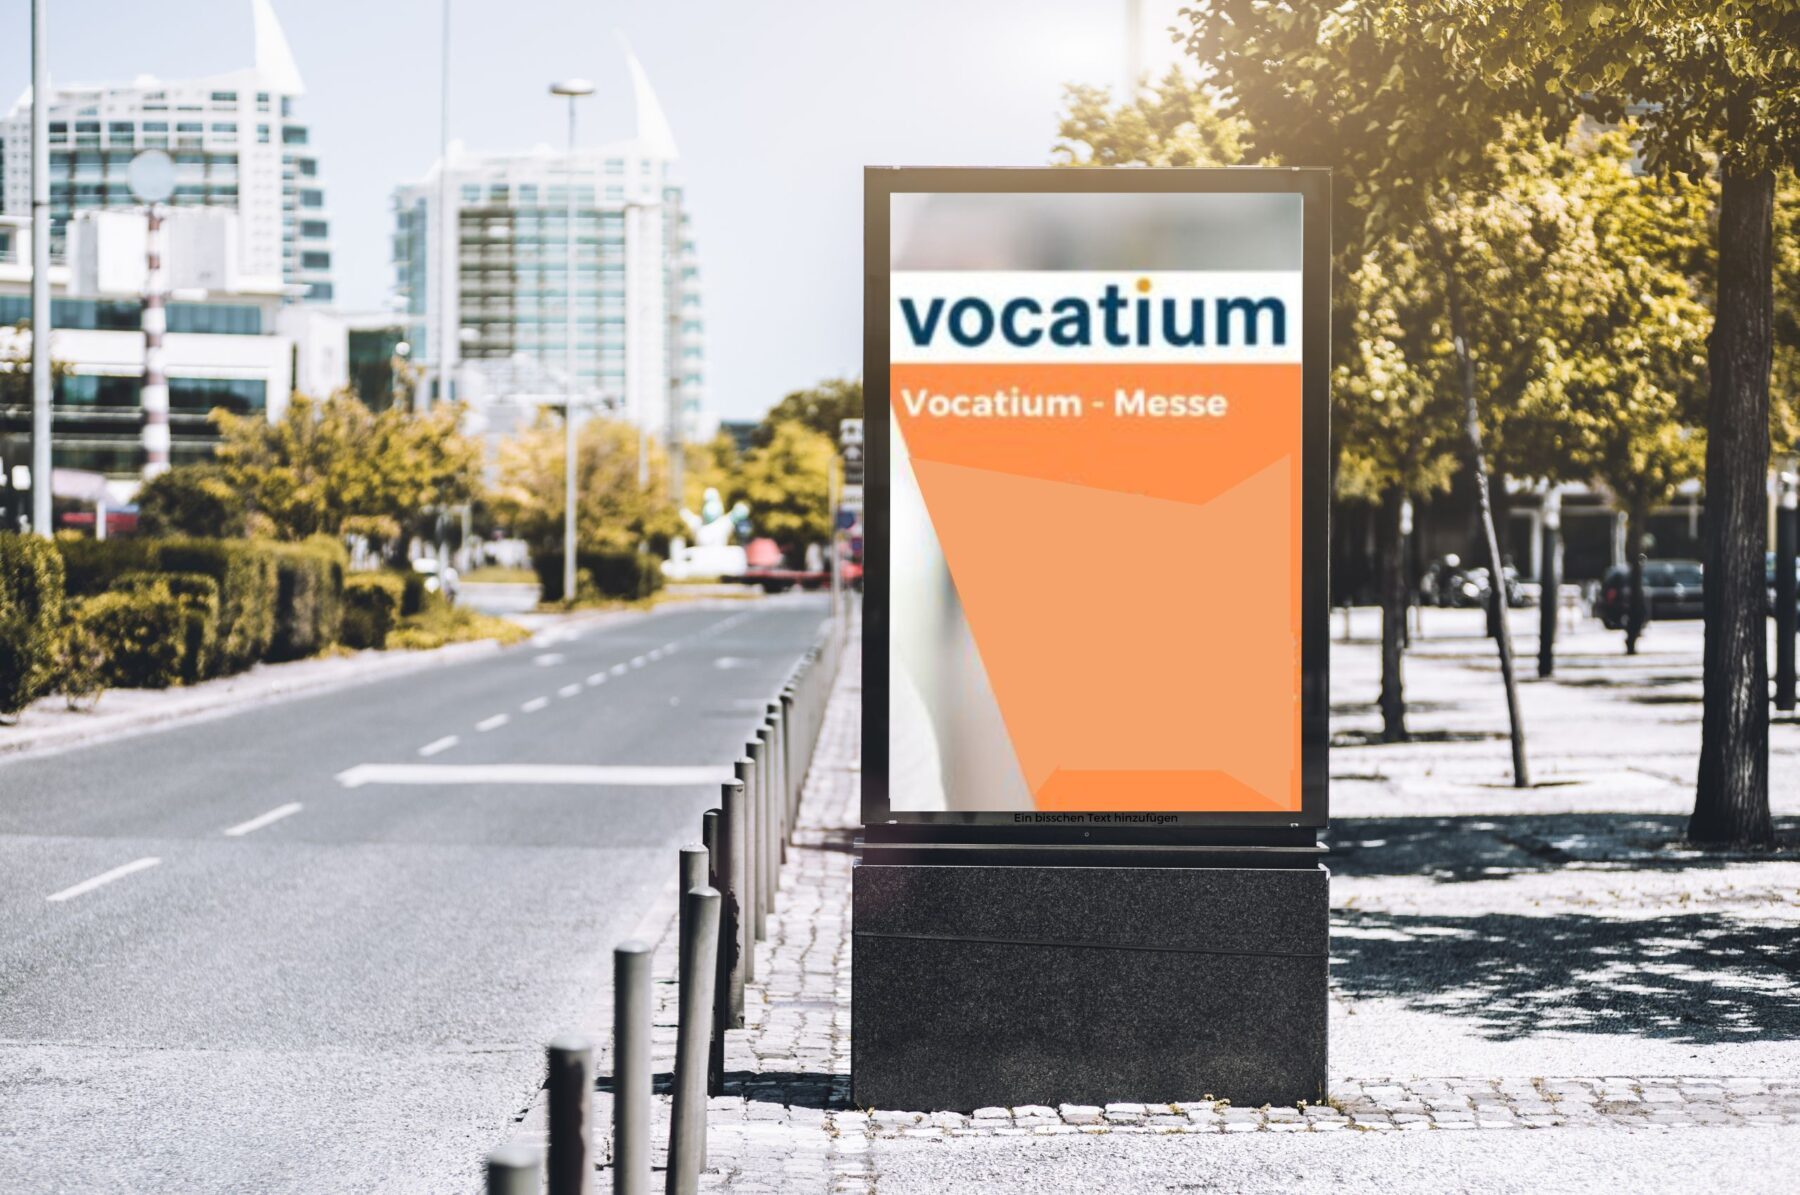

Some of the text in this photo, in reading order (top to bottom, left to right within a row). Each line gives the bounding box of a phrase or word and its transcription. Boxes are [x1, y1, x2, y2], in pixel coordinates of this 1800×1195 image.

[899, 278, 1287, 348] vocatium
[901, 387, 1083, 418] Vocatium
[1113, 388, 1229, 418] Messe
